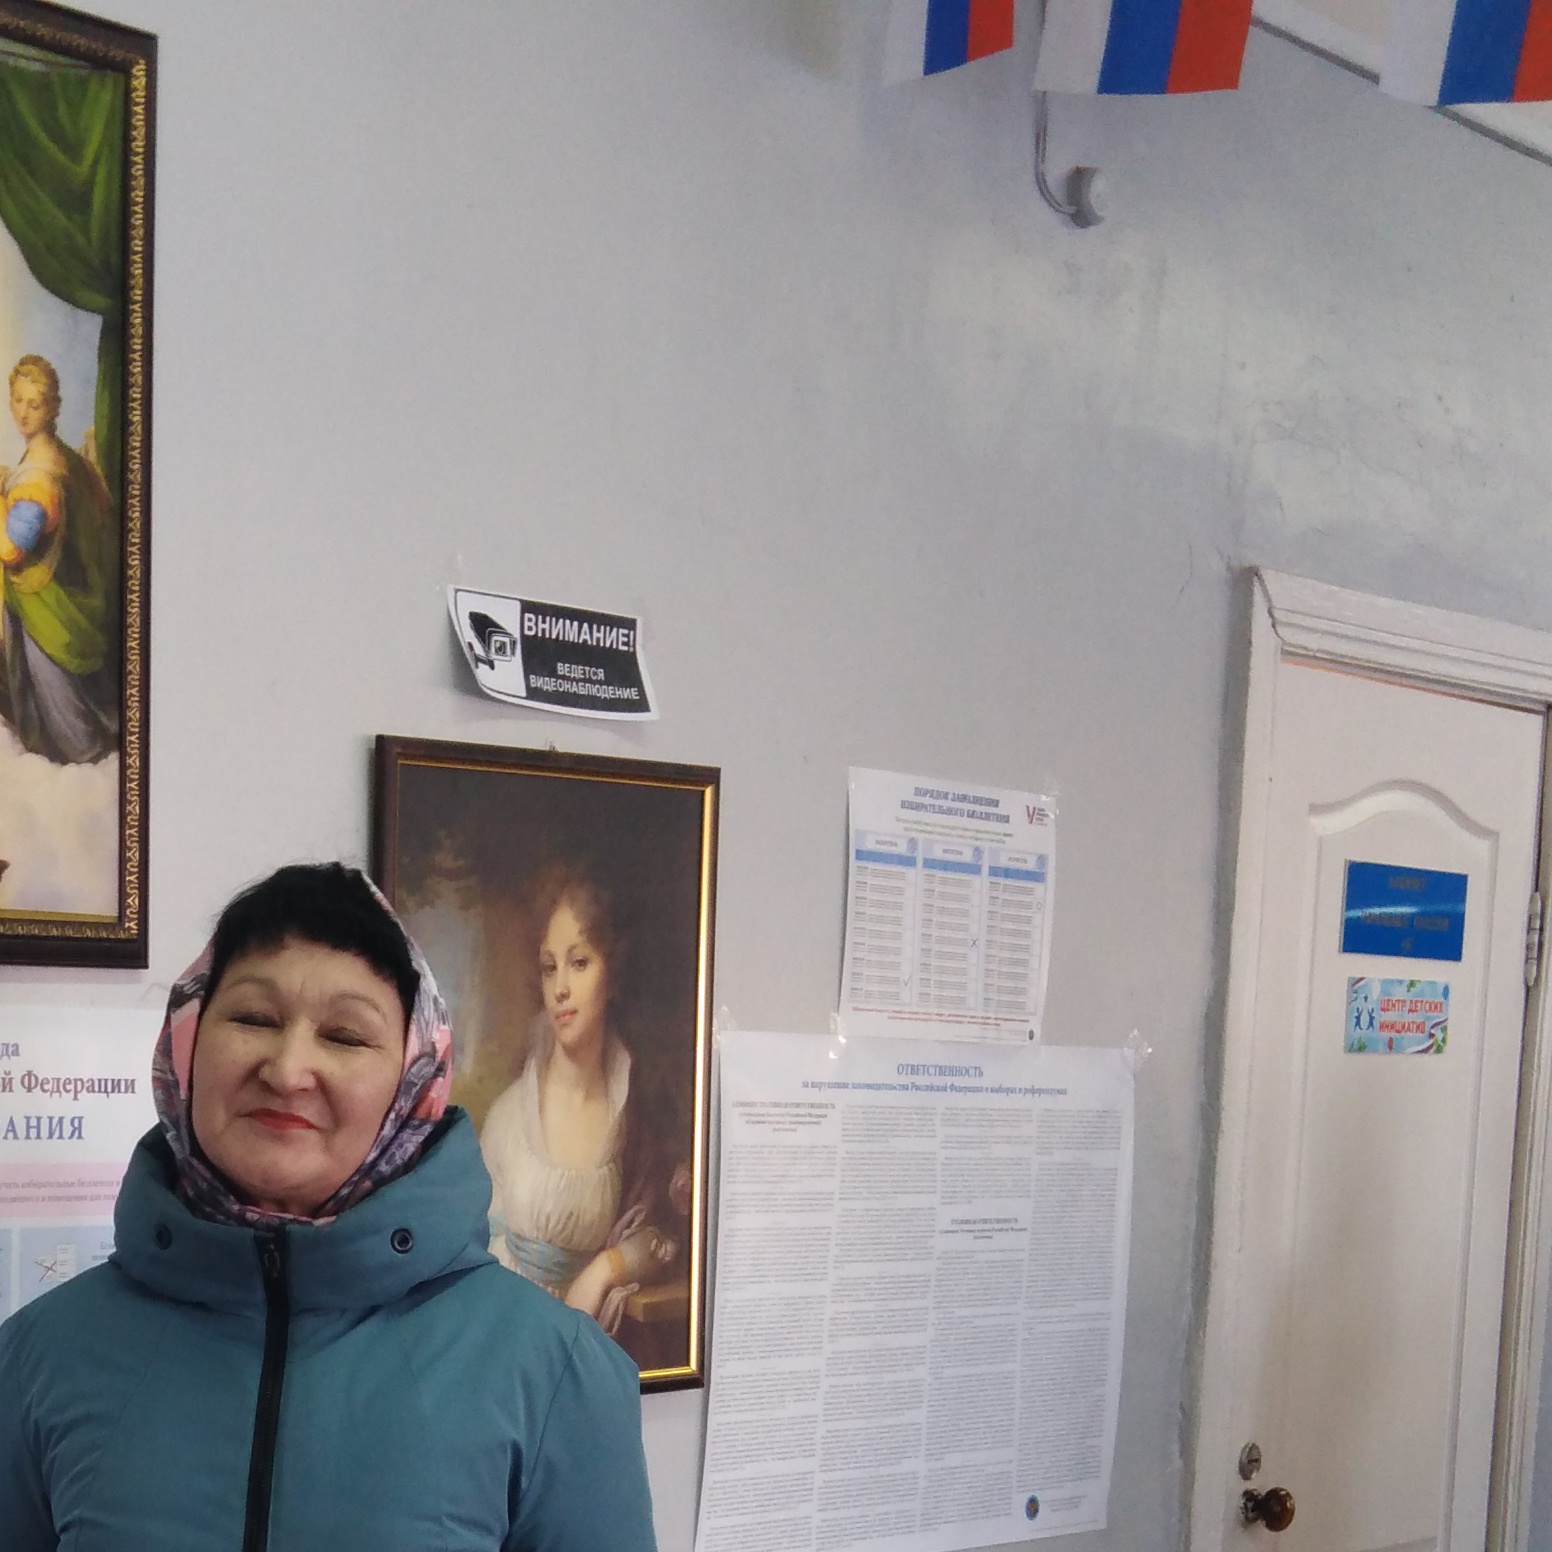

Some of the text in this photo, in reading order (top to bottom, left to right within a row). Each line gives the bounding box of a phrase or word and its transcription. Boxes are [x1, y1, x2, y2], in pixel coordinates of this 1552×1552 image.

[523, 612, 635, 652] ВНИМАНИЕ!
[557, 662, 605, 681] ВЕДЕТСЯ
[529, 674, 640, 700] ВИДЕОНАБЛЮДЕНИЕ
[1380, 998, 1443, 1014] ЦЕНТР ДЕТСКИХ
[897, 1063, 984, 1078] ОТВЕТСТВЕННОСТЬ
[20, 1070, 136, 1101] Федерации
